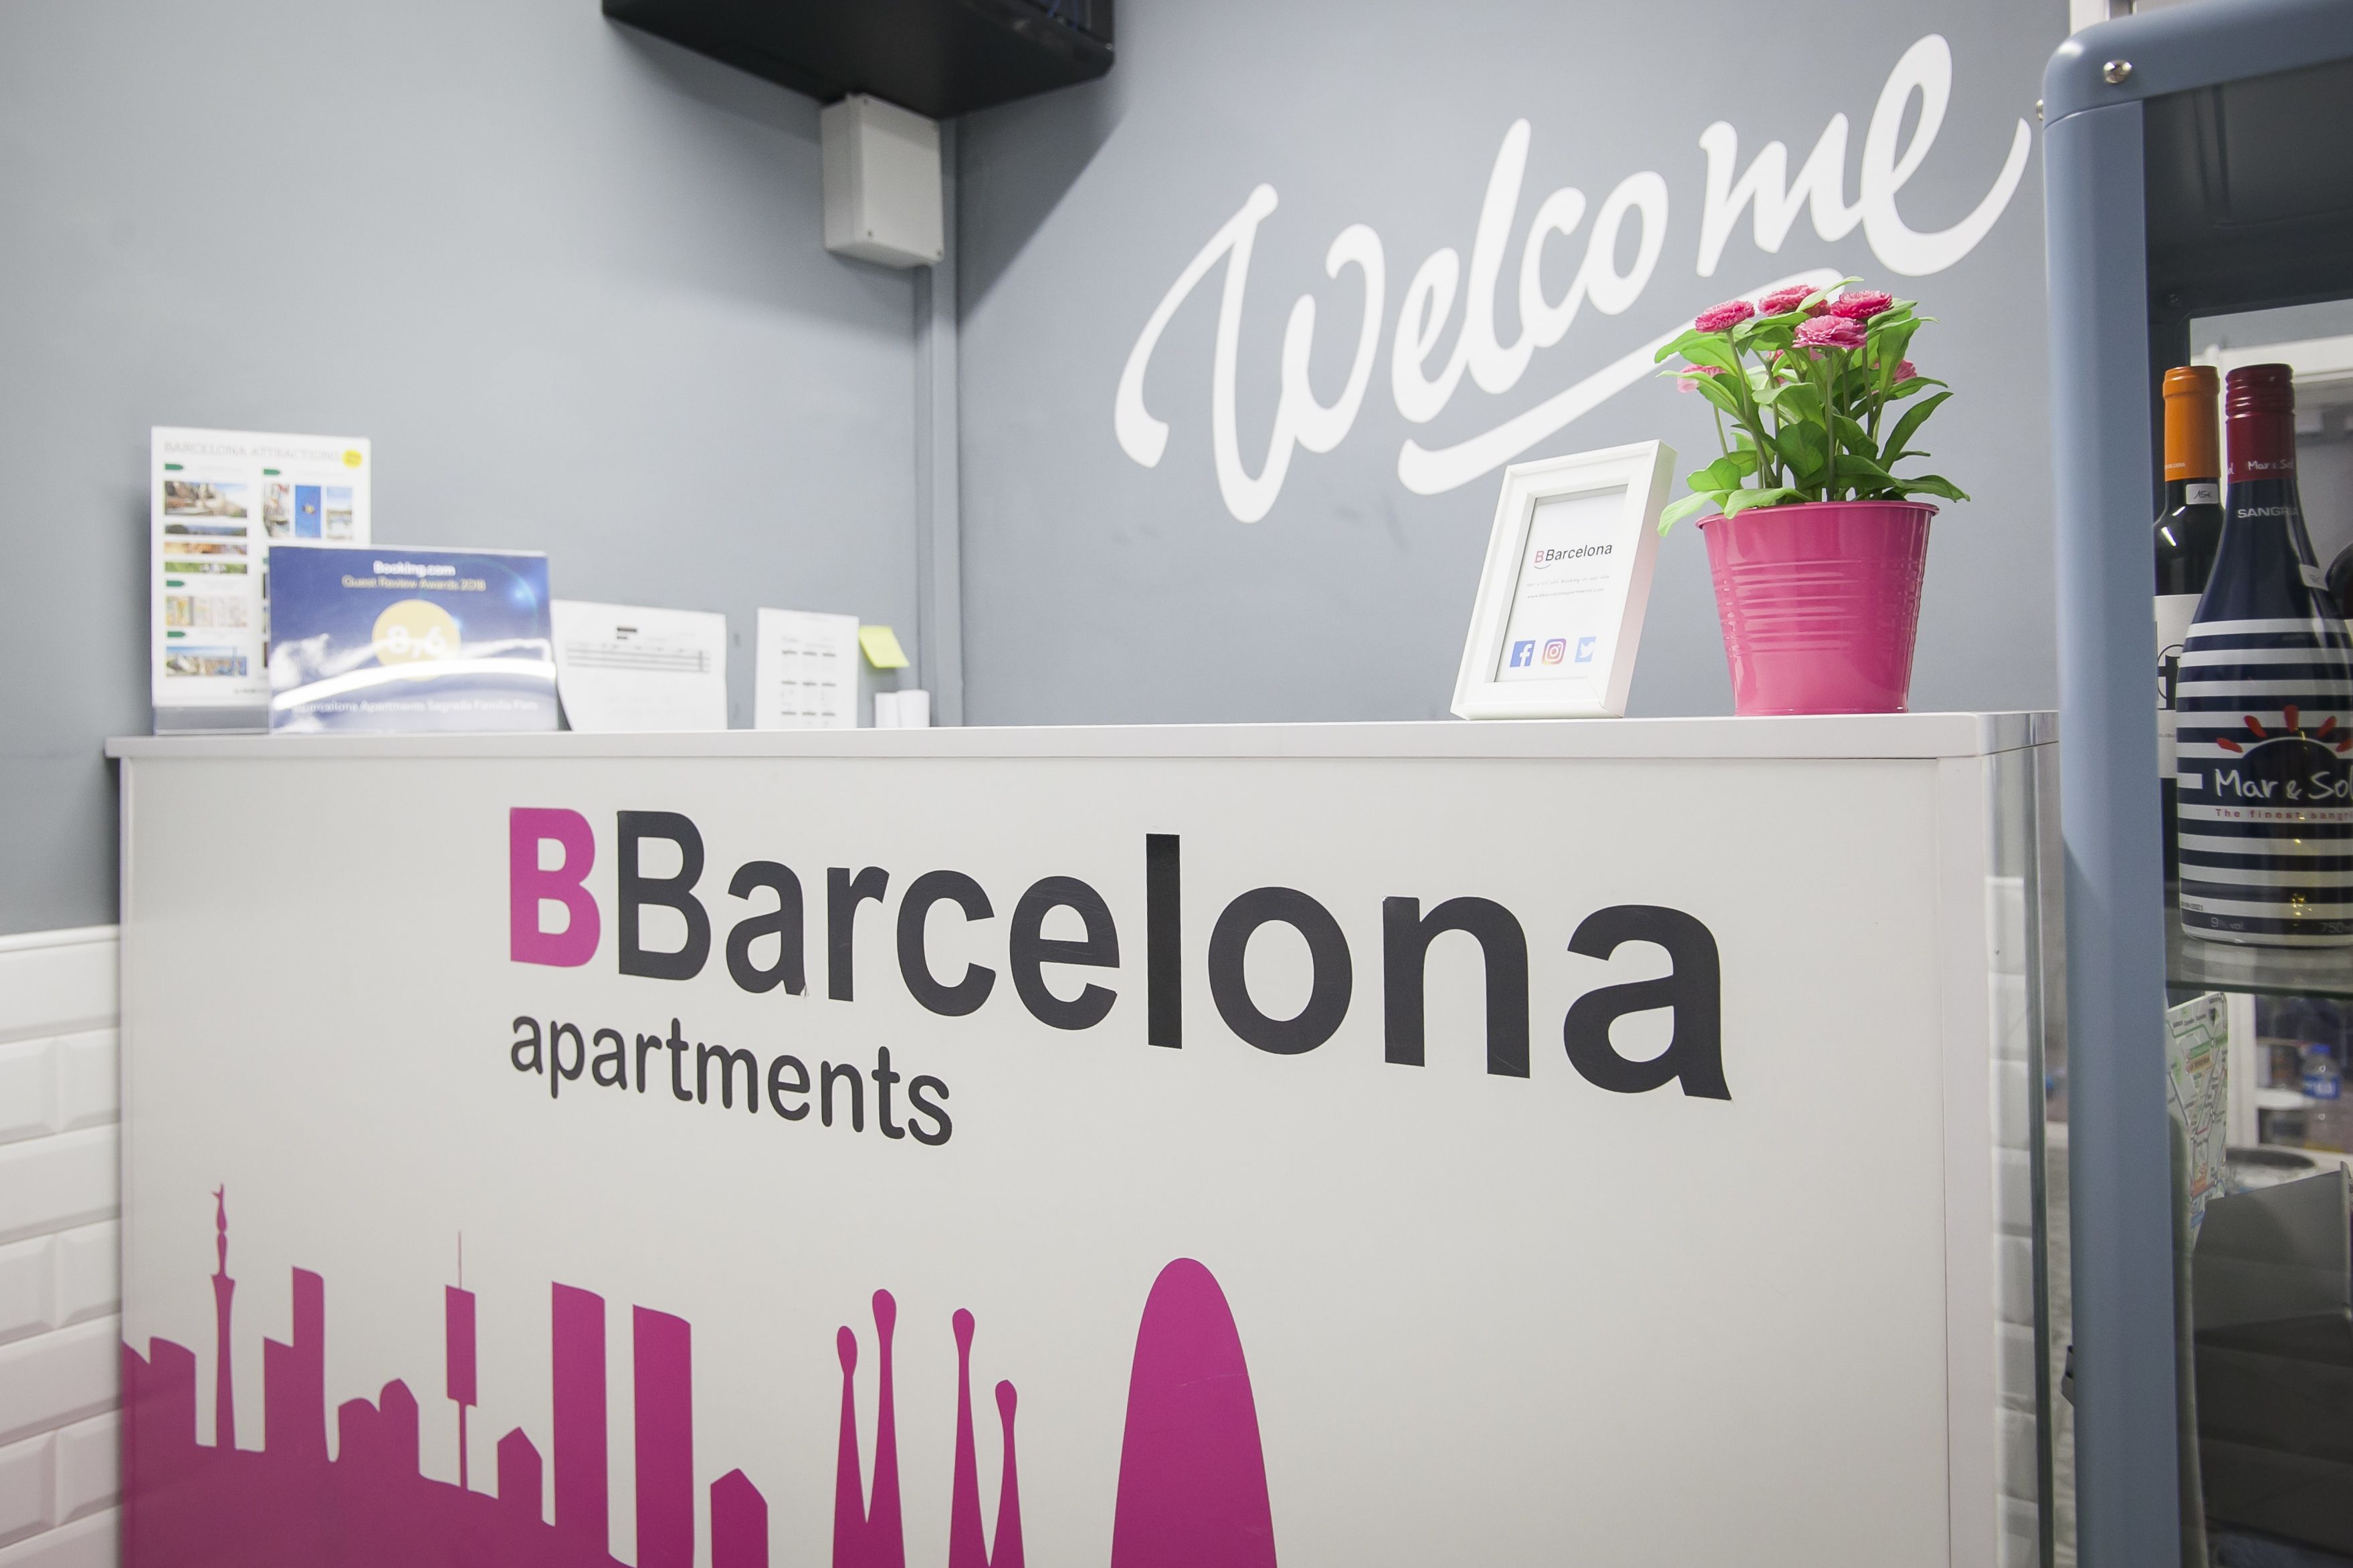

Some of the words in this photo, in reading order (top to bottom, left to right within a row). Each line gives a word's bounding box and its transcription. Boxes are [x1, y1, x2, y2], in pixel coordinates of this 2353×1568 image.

[1114, 34, 2031, 523] Welcome
[1534, 544, 1613, 564] BBarcelona
[342, 574, 377, 588] Guest
[377, 576, 418, 590] Review
[417, 578, 459, 590] Awards
[373, 560, 456, 578] Booking.com
[2215, 768, 2278, 798] Mar
[2285, 779, 2303, 800] &
[2308, 764, 2353, 800] Sol
[2215, 808, 2241, 818] The
[2250, 810, 2304, 819] finest
[510, 807, 1732, 1101] BBarcelona
[511, 1015, 953, 1147] apartments
